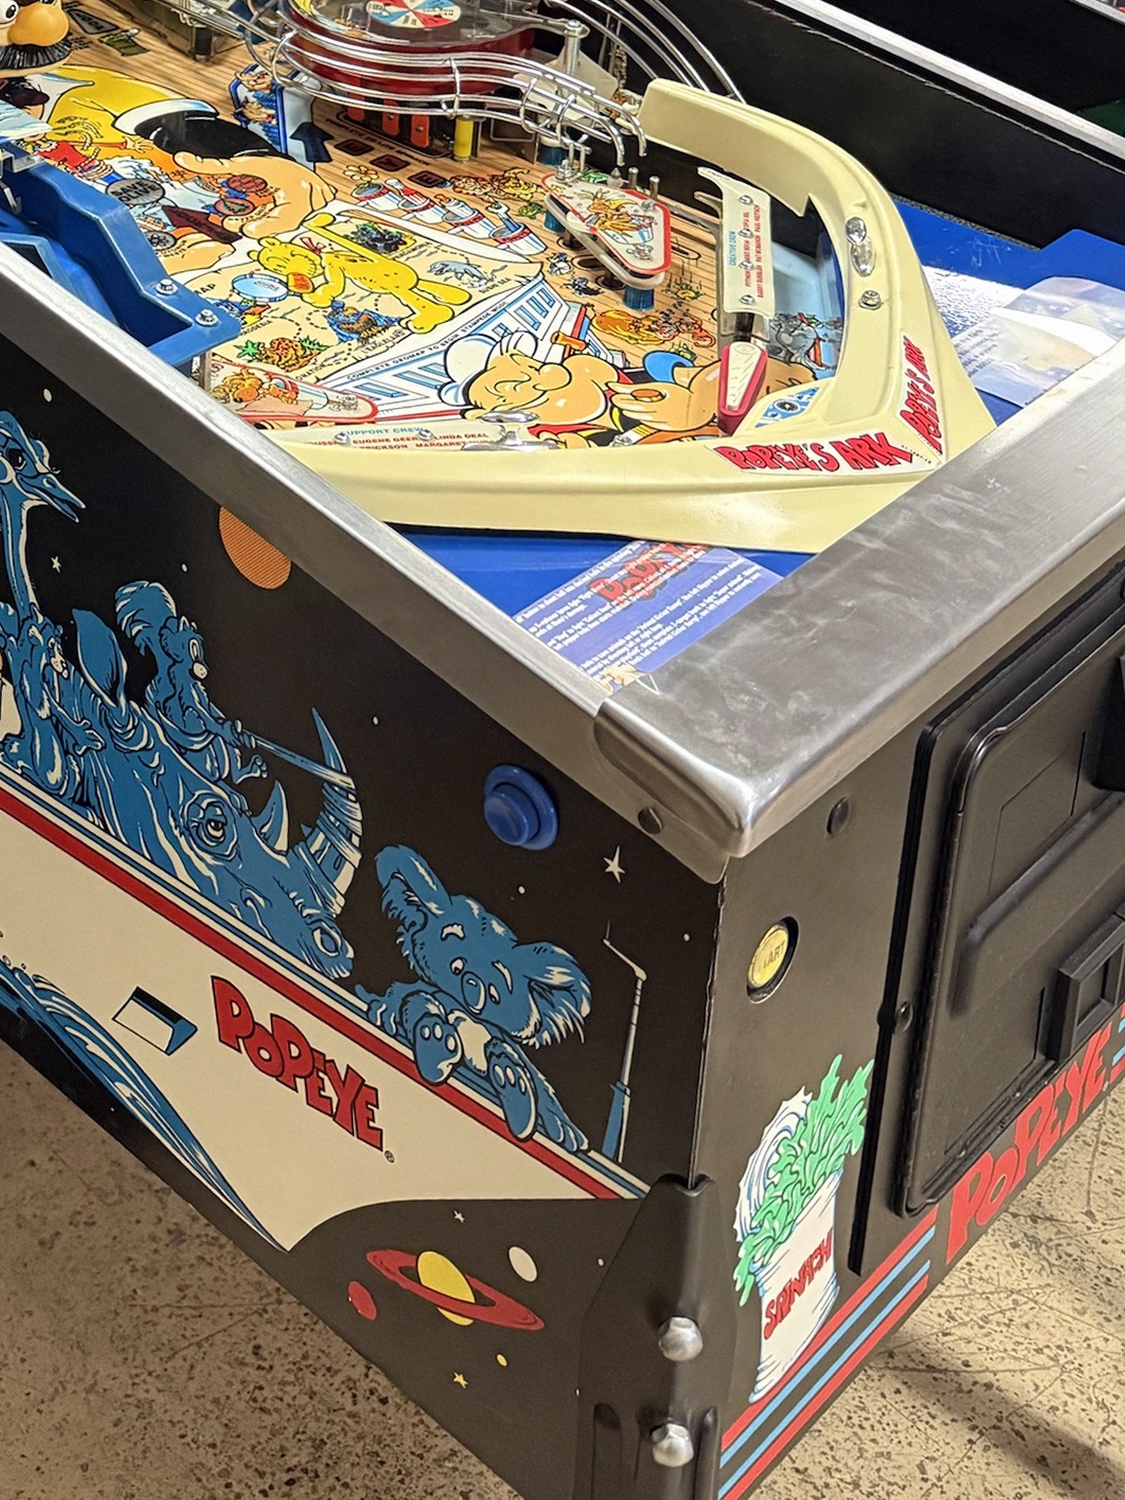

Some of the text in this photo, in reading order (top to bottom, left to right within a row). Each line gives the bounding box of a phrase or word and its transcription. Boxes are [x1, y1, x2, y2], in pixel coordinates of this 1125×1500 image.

[111, 180, 147, 196] SAVE
[118, 184, 161, 202] OLIVE
[347, 362, 390, 380] COMPLETE
[441, 334, 460, 347] BEGIN
[461, 313, 492, 333] STAMPEDE
[903, 335, 932, 382] ARK
[393, 426, 424, 435] CREW
[899, 368, 943, 455] POPEYE'S
[352, 437, 392, 445] EUGENE
[713, 441, 841, 473] POPEYE'S
[829, 431, 913, 471] ARK
[210, 974, 383, 1153] POPEYE
[945, 1020, 1112, 1267] POPEYE
[763, 1232, 834, 1340] SPINACH
